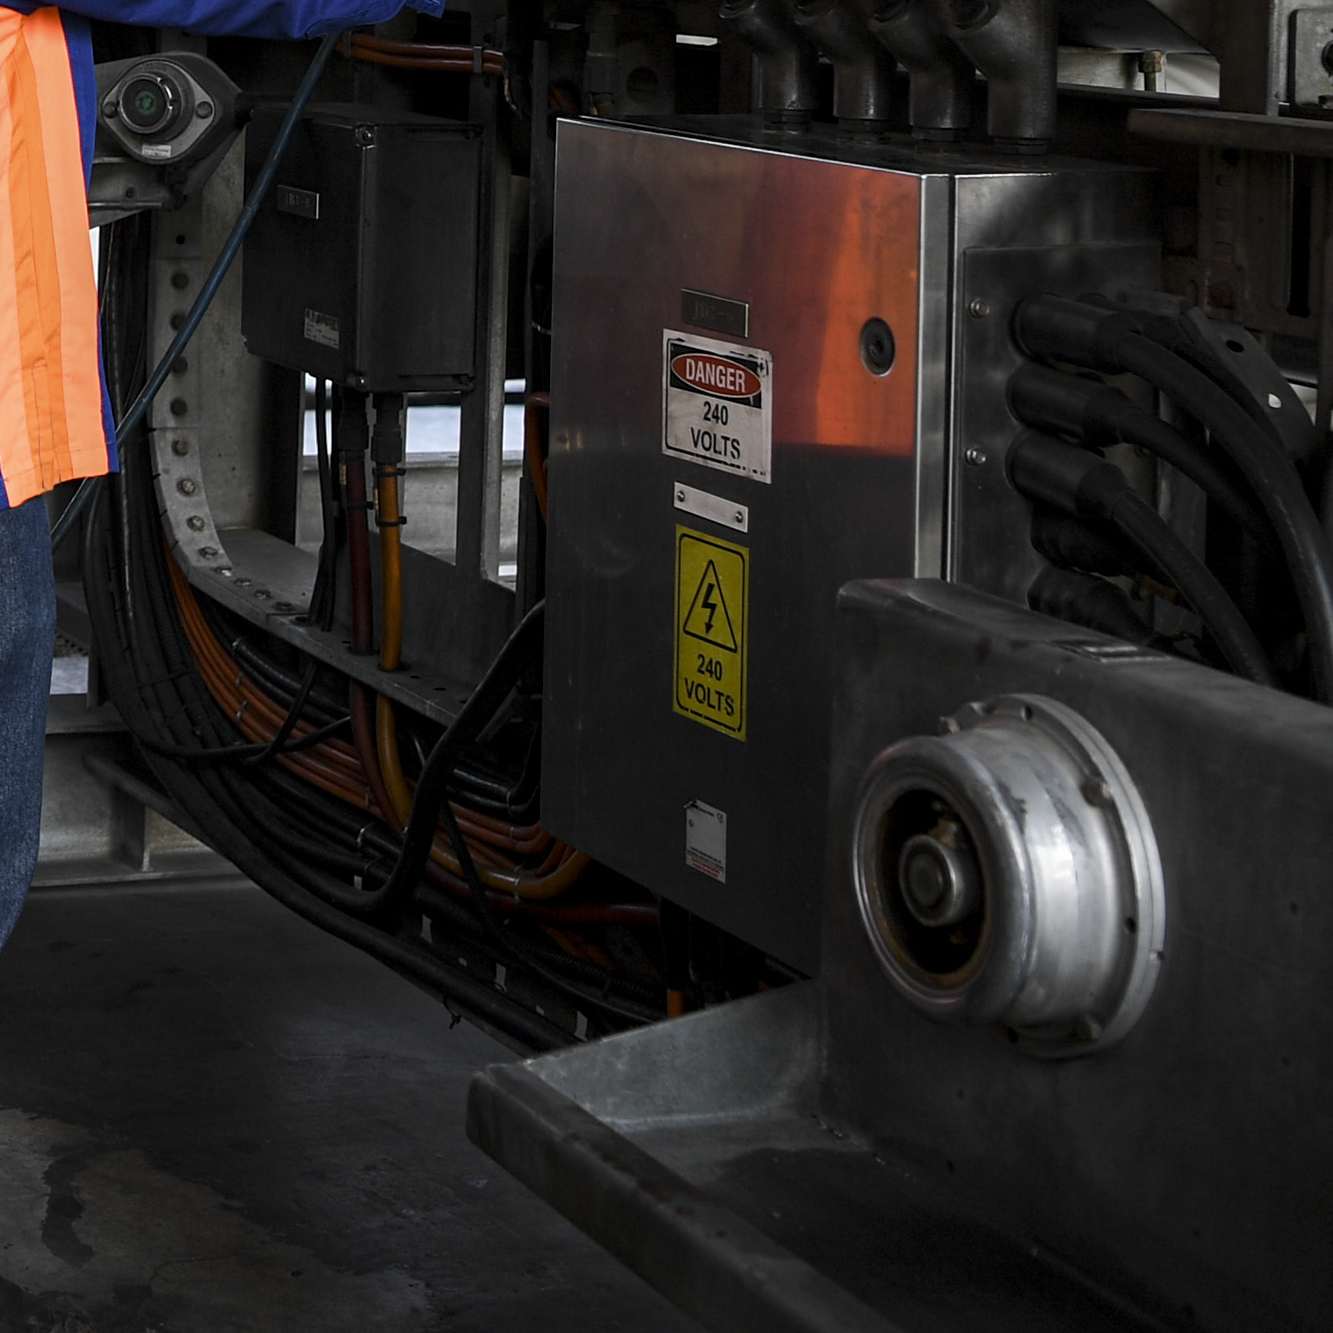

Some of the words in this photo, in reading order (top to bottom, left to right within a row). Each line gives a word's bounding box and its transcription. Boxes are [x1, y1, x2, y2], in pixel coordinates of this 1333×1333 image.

[685, 357, 746, 394] DANGER
[703, 401, 729, 427] 240
[690, 426, 741, 460] VOLTS
[697, 652, 723, 681] 240
[684, 676, 735, 717] VOLTS
